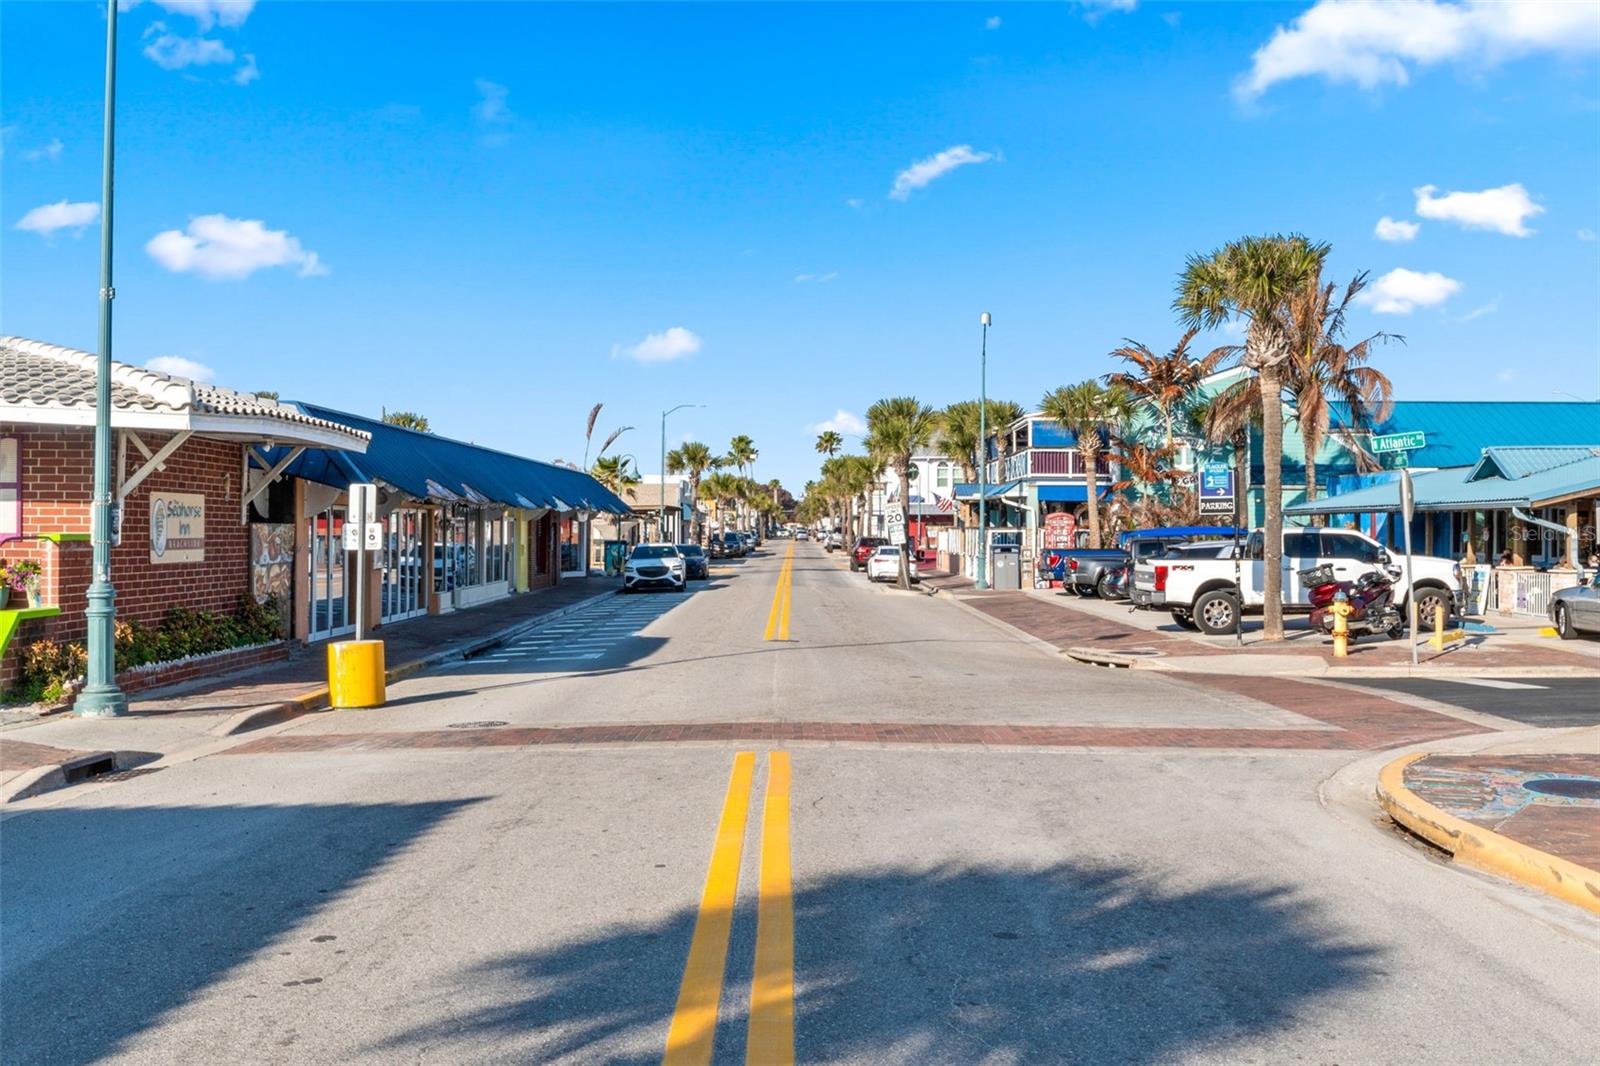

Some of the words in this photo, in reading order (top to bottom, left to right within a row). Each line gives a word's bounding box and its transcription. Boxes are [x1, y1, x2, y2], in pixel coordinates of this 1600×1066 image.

[1380, 435, 1416, 449] Atlantic
[167, 500, 202, 518] Seahorse
[1201, 502, 1233, 510] PARKING
[887, 513, 902, 523] 20
[178, 519, 191, 536] Inn
